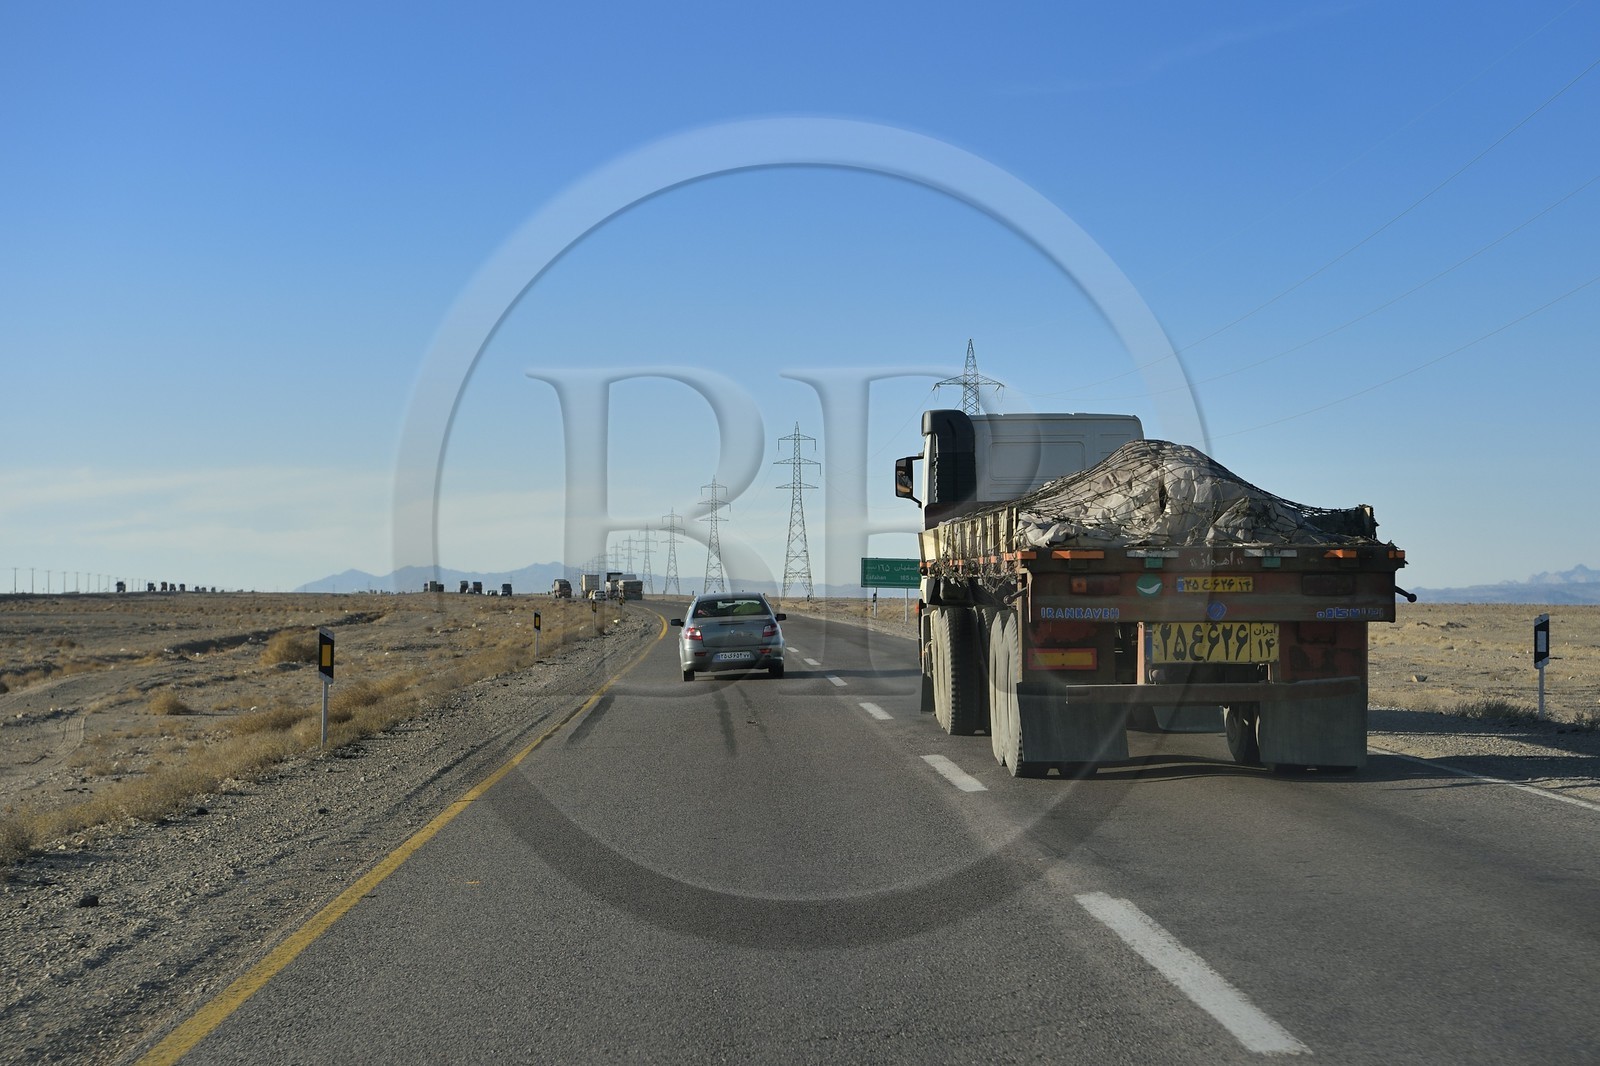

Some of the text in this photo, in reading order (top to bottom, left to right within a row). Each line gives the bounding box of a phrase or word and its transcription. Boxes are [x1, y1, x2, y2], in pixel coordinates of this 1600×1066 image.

[1040, 607, 1120, 619] IRANKAVEH
[1253, 625, 1276, 636] ایران
[1258, 638, 1276, 658] ۱۴
